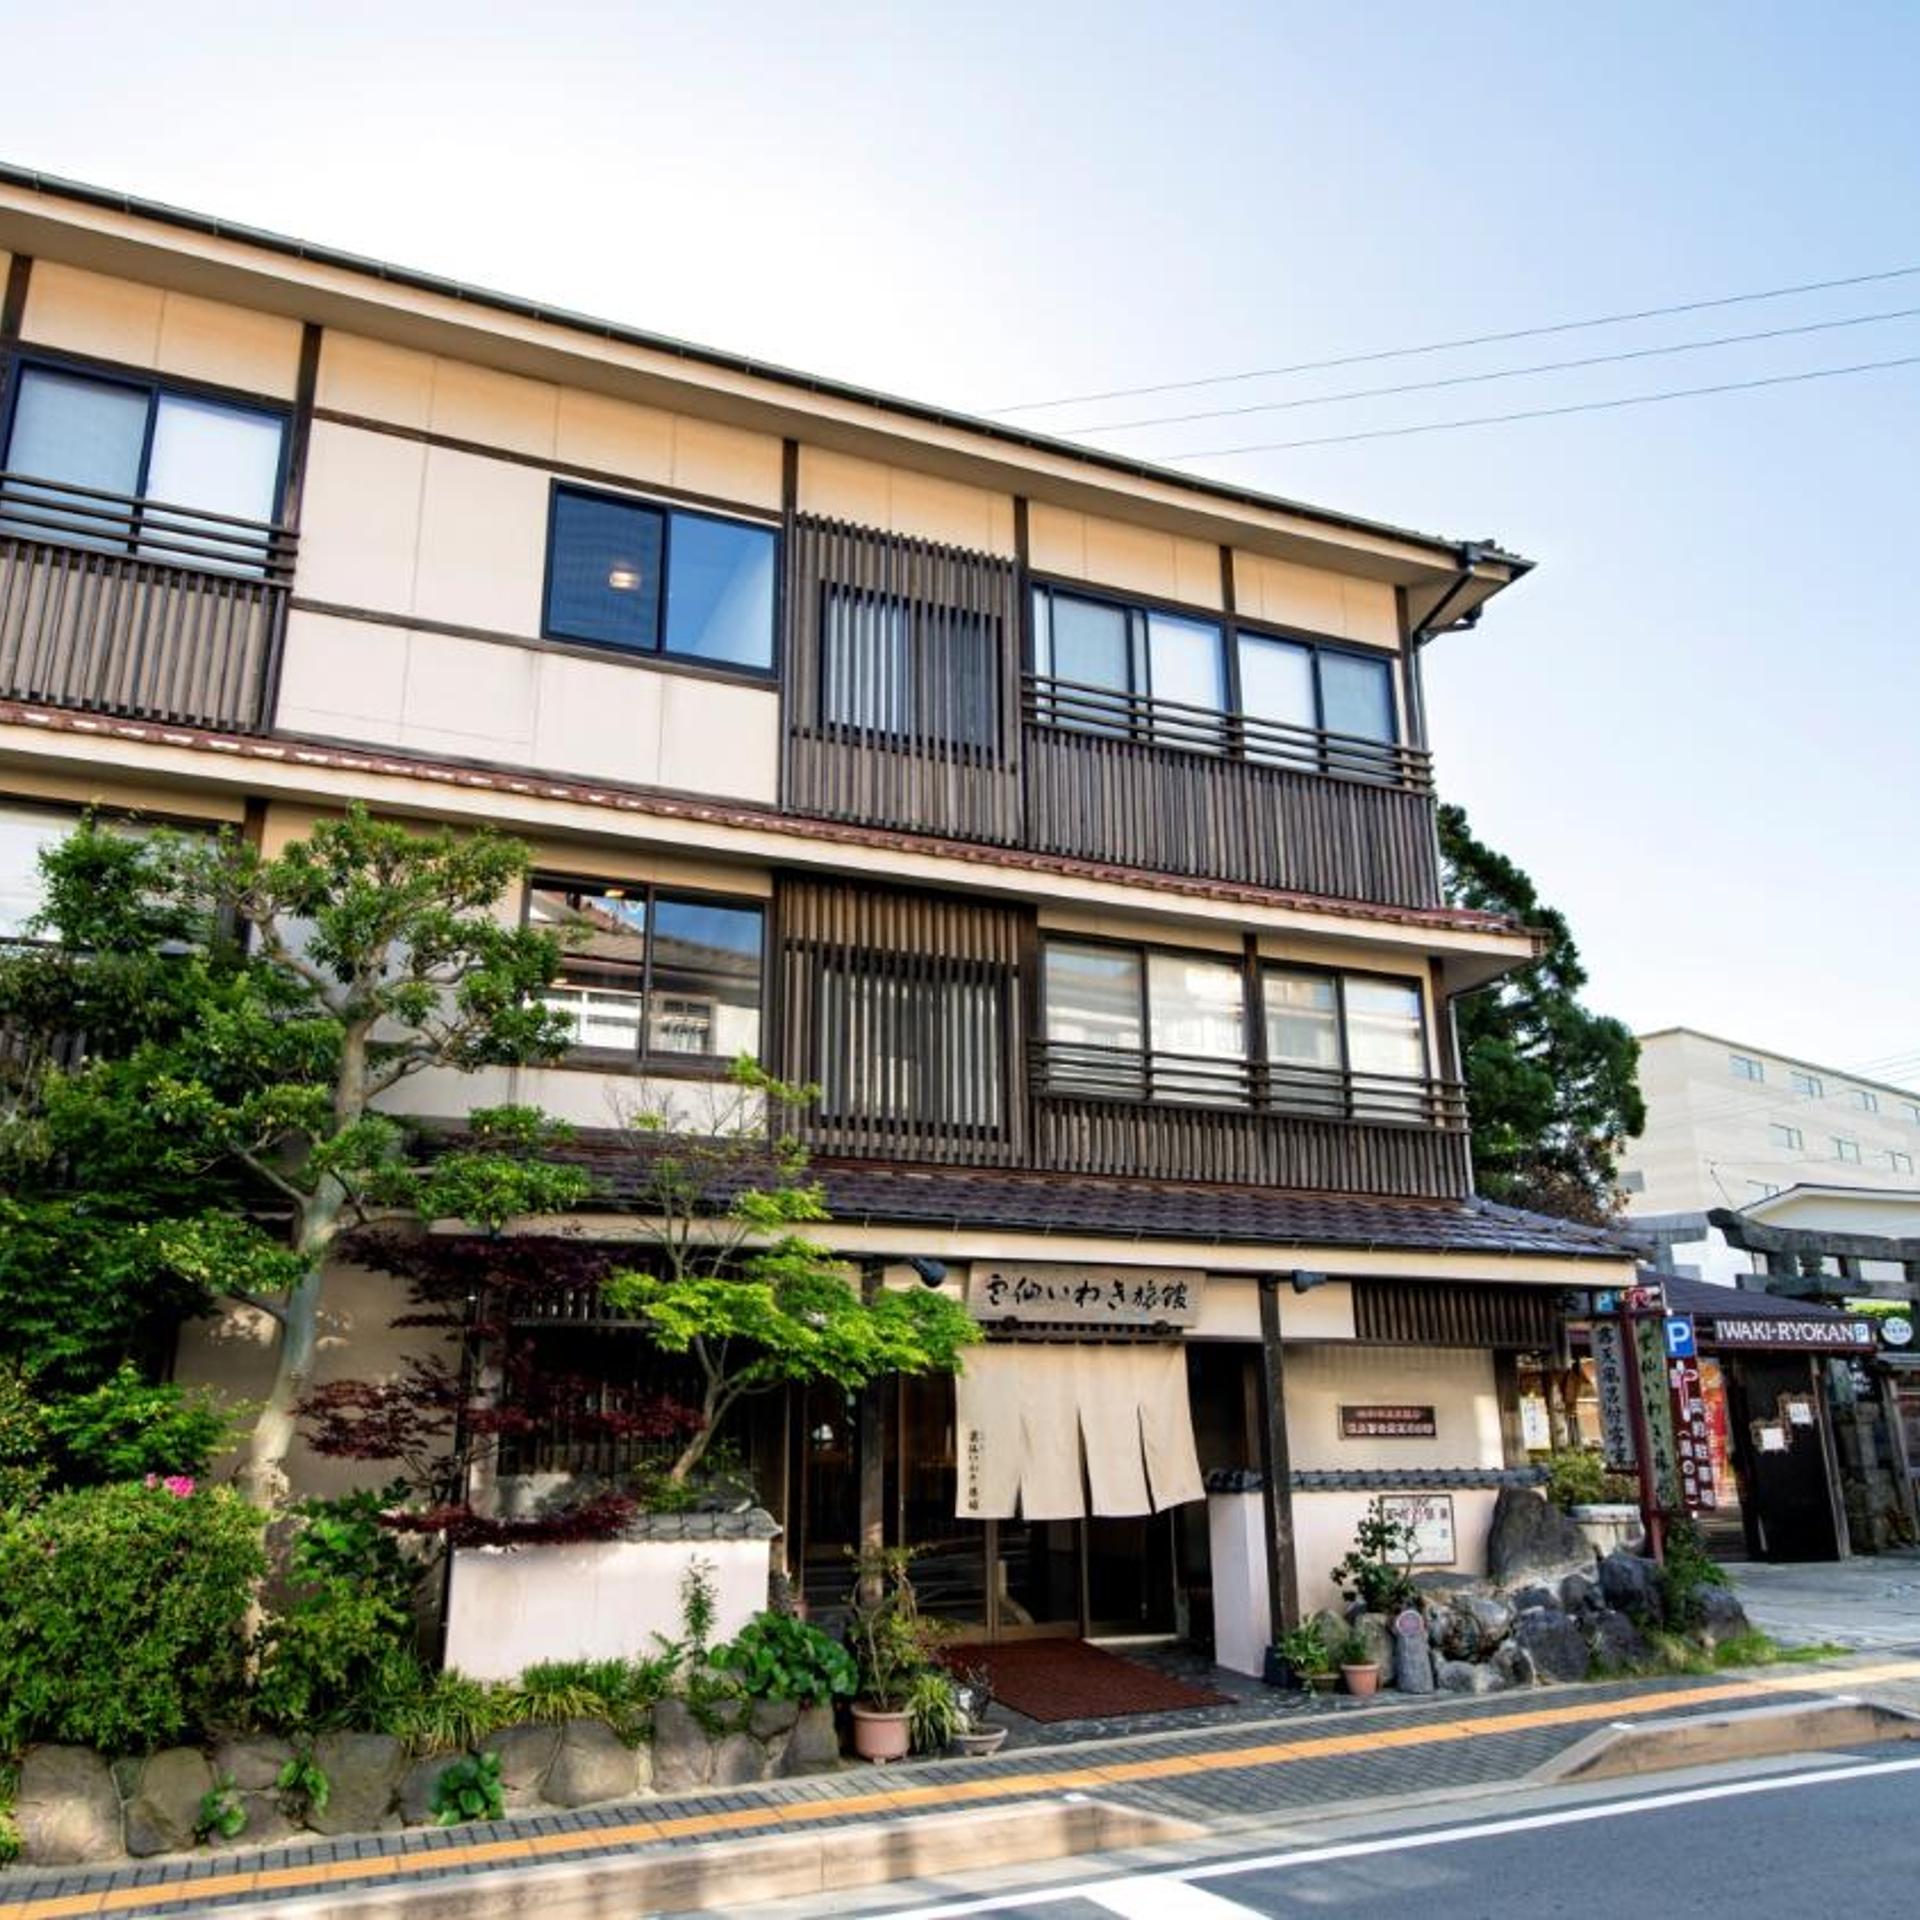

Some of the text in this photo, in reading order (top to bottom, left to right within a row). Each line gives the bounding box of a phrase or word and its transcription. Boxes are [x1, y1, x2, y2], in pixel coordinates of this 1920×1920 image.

[986, 1273, 1188, 1310] 雲仙いわき旅館
[1667, 1321, 1691, 1352] P
[1715, 1320, 1854, 1342] IWAKI-RYOKAN
